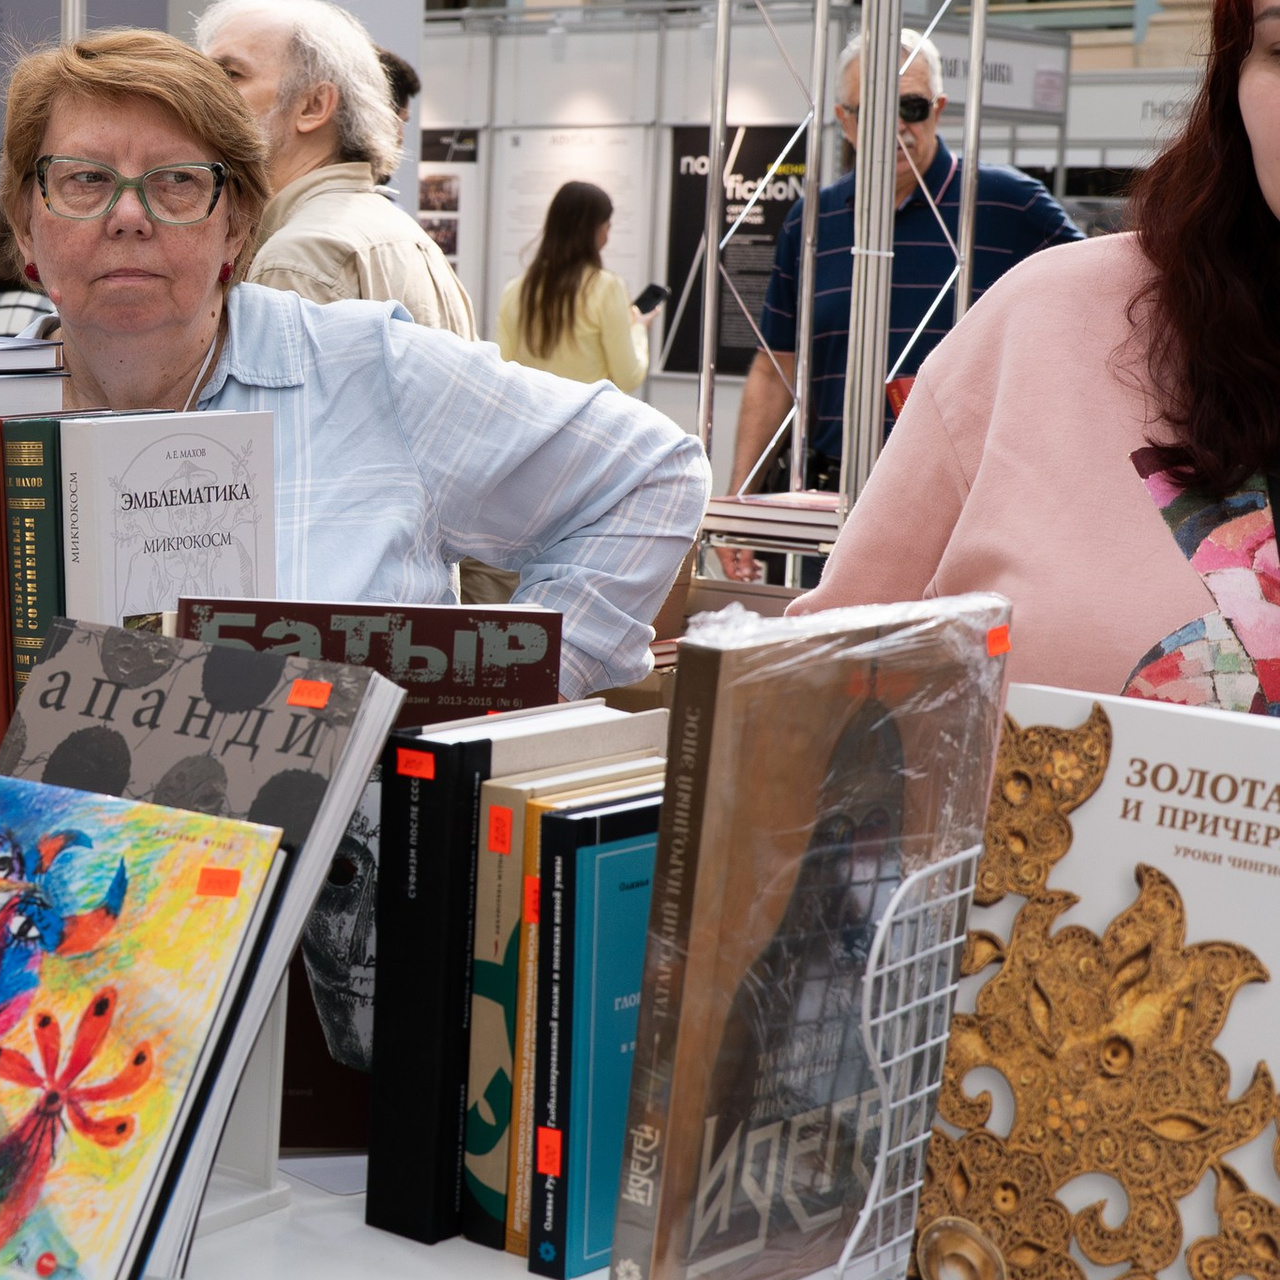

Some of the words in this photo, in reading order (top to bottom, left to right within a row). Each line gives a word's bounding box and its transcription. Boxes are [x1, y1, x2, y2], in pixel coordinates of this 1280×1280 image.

[180, 448, 207, 459] МАХОВ
[15, 477, 43, 488] МАХОВ
[120, 481, 251, 512] ЭМБЛЕМАТИКА
[70, 470, 81, 564] МИКРОКОСМ
[143, 531, 232, 555] МИКРОКОСМ
[13, 516, 23, 628] ИЗБРАННЫЕ
[24, 518, 38, 630] СОЧИНЕНИЯ
[669, 767, 696, 894] НАРОДНЫЙ
[683, 705, 704, 766] ЭПОС
[1120, 797, 1143, 822] И
[410, 805, 420, 847] ПОСЛЕ
[1173, 844, 1223, 865] УРОКИ
[408, 855, 418, 899] СУФИЗМ
